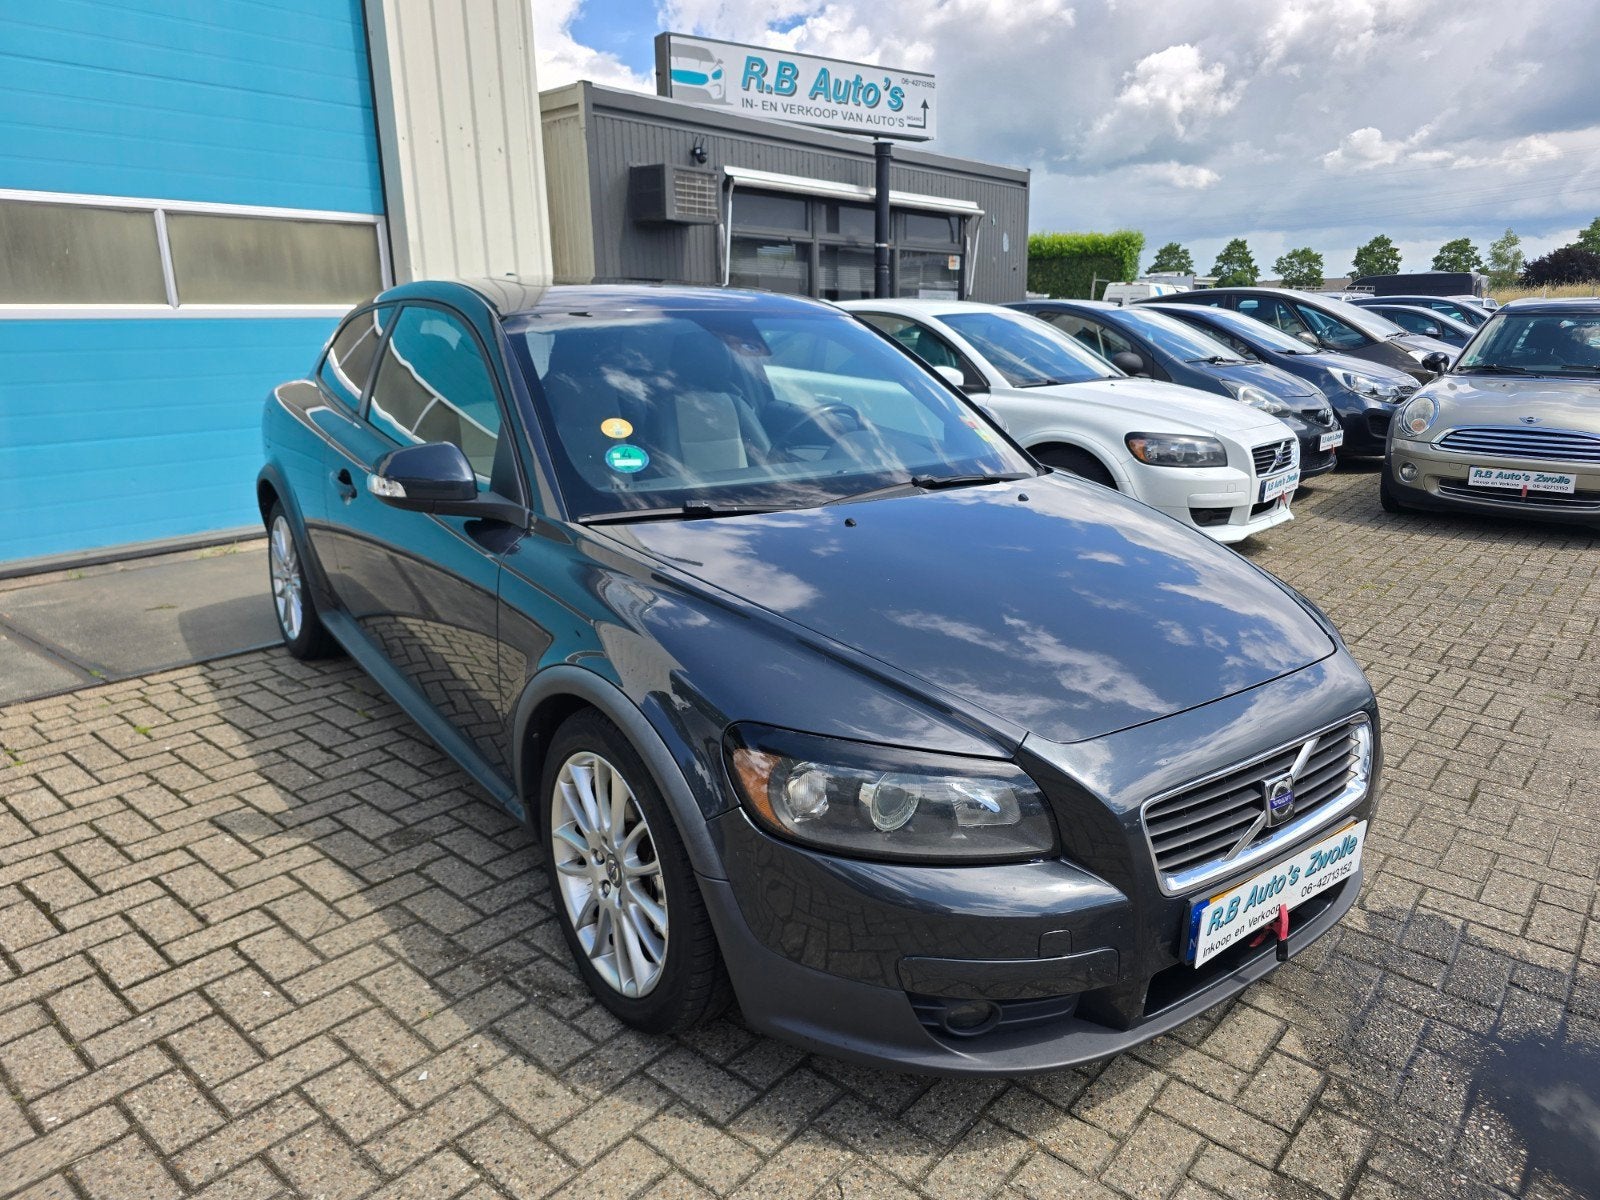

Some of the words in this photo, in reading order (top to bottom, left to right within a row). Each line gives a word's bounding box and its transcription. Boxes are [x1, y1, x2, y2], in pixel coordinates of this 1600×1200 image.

[741, 56, 799, 97] R.B
[808, 67, 905, 112] Auto's
[741, 98, 758, 109] IN-
[762, 100, 778, 112] EN
[781, 102, 838, 118] VERKOOP
[841, 110, 863, 122] VAN
[866, 115, 905, 127] AUTO'S
[1495, 471, 1531, 481] Auto's
[1533, 474, 1571, 485] Zwolle
[1206, 895, 1242, 937] R.B
[1243, 864, 1301, 914] Auto's
[1304, 834, 1358, 878] Zwolle
[1300, 861, 1353, 898] 06-42713152
[1203, 933, 1231, 959] Inkoop
[1234, 925, 1245, 937] en
